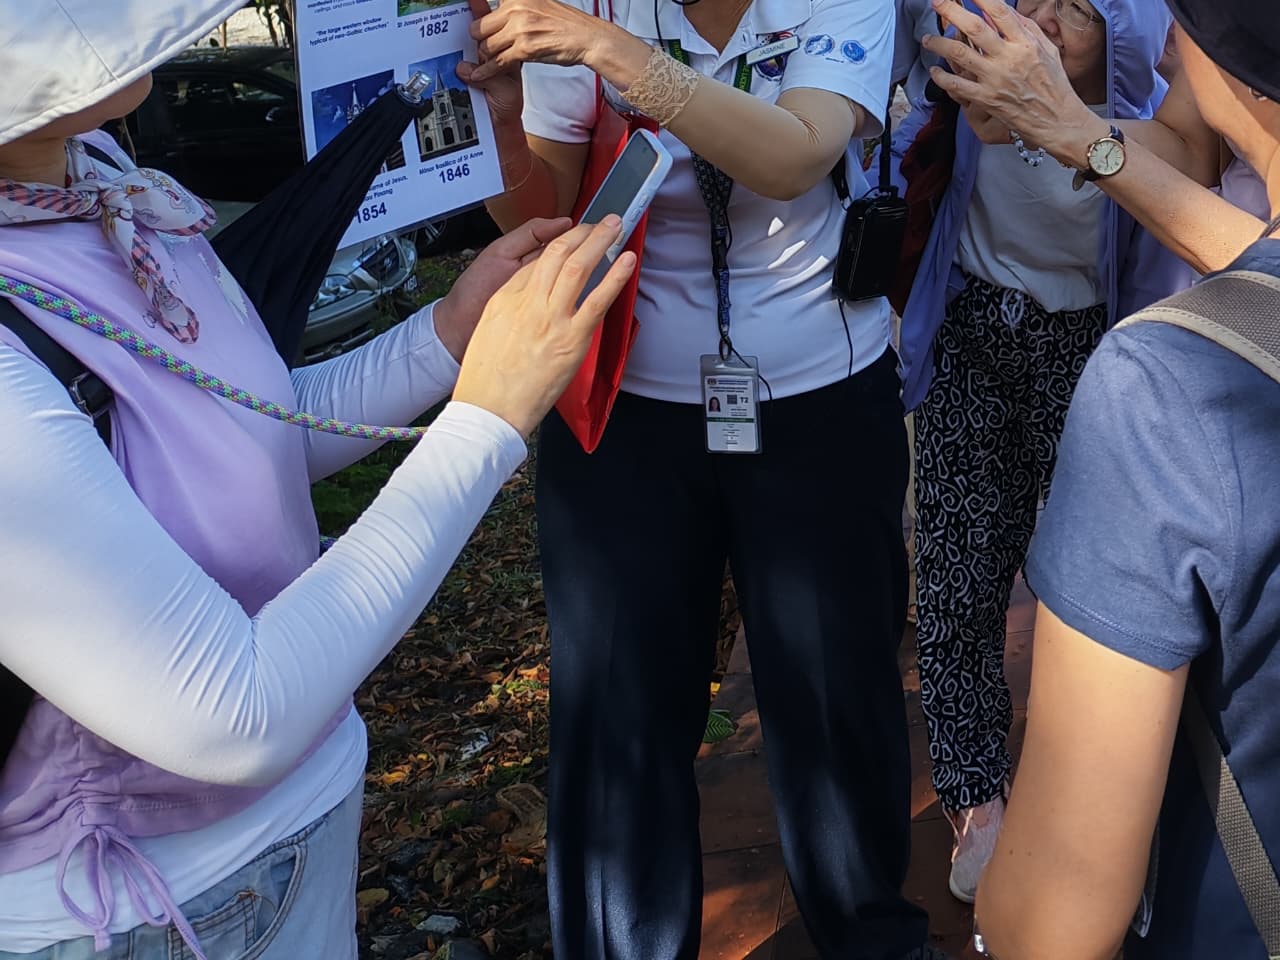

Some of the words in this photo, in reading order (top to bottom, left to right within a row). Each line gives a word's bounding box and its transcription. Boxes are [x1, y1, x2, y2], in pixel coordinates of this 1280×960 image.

[419, 20, 449, 38] 1882
[758, 42, 786, 57] JASMINE
[439, 163, 470, 184] 1846
[356, 201, 387, 224] 1854
